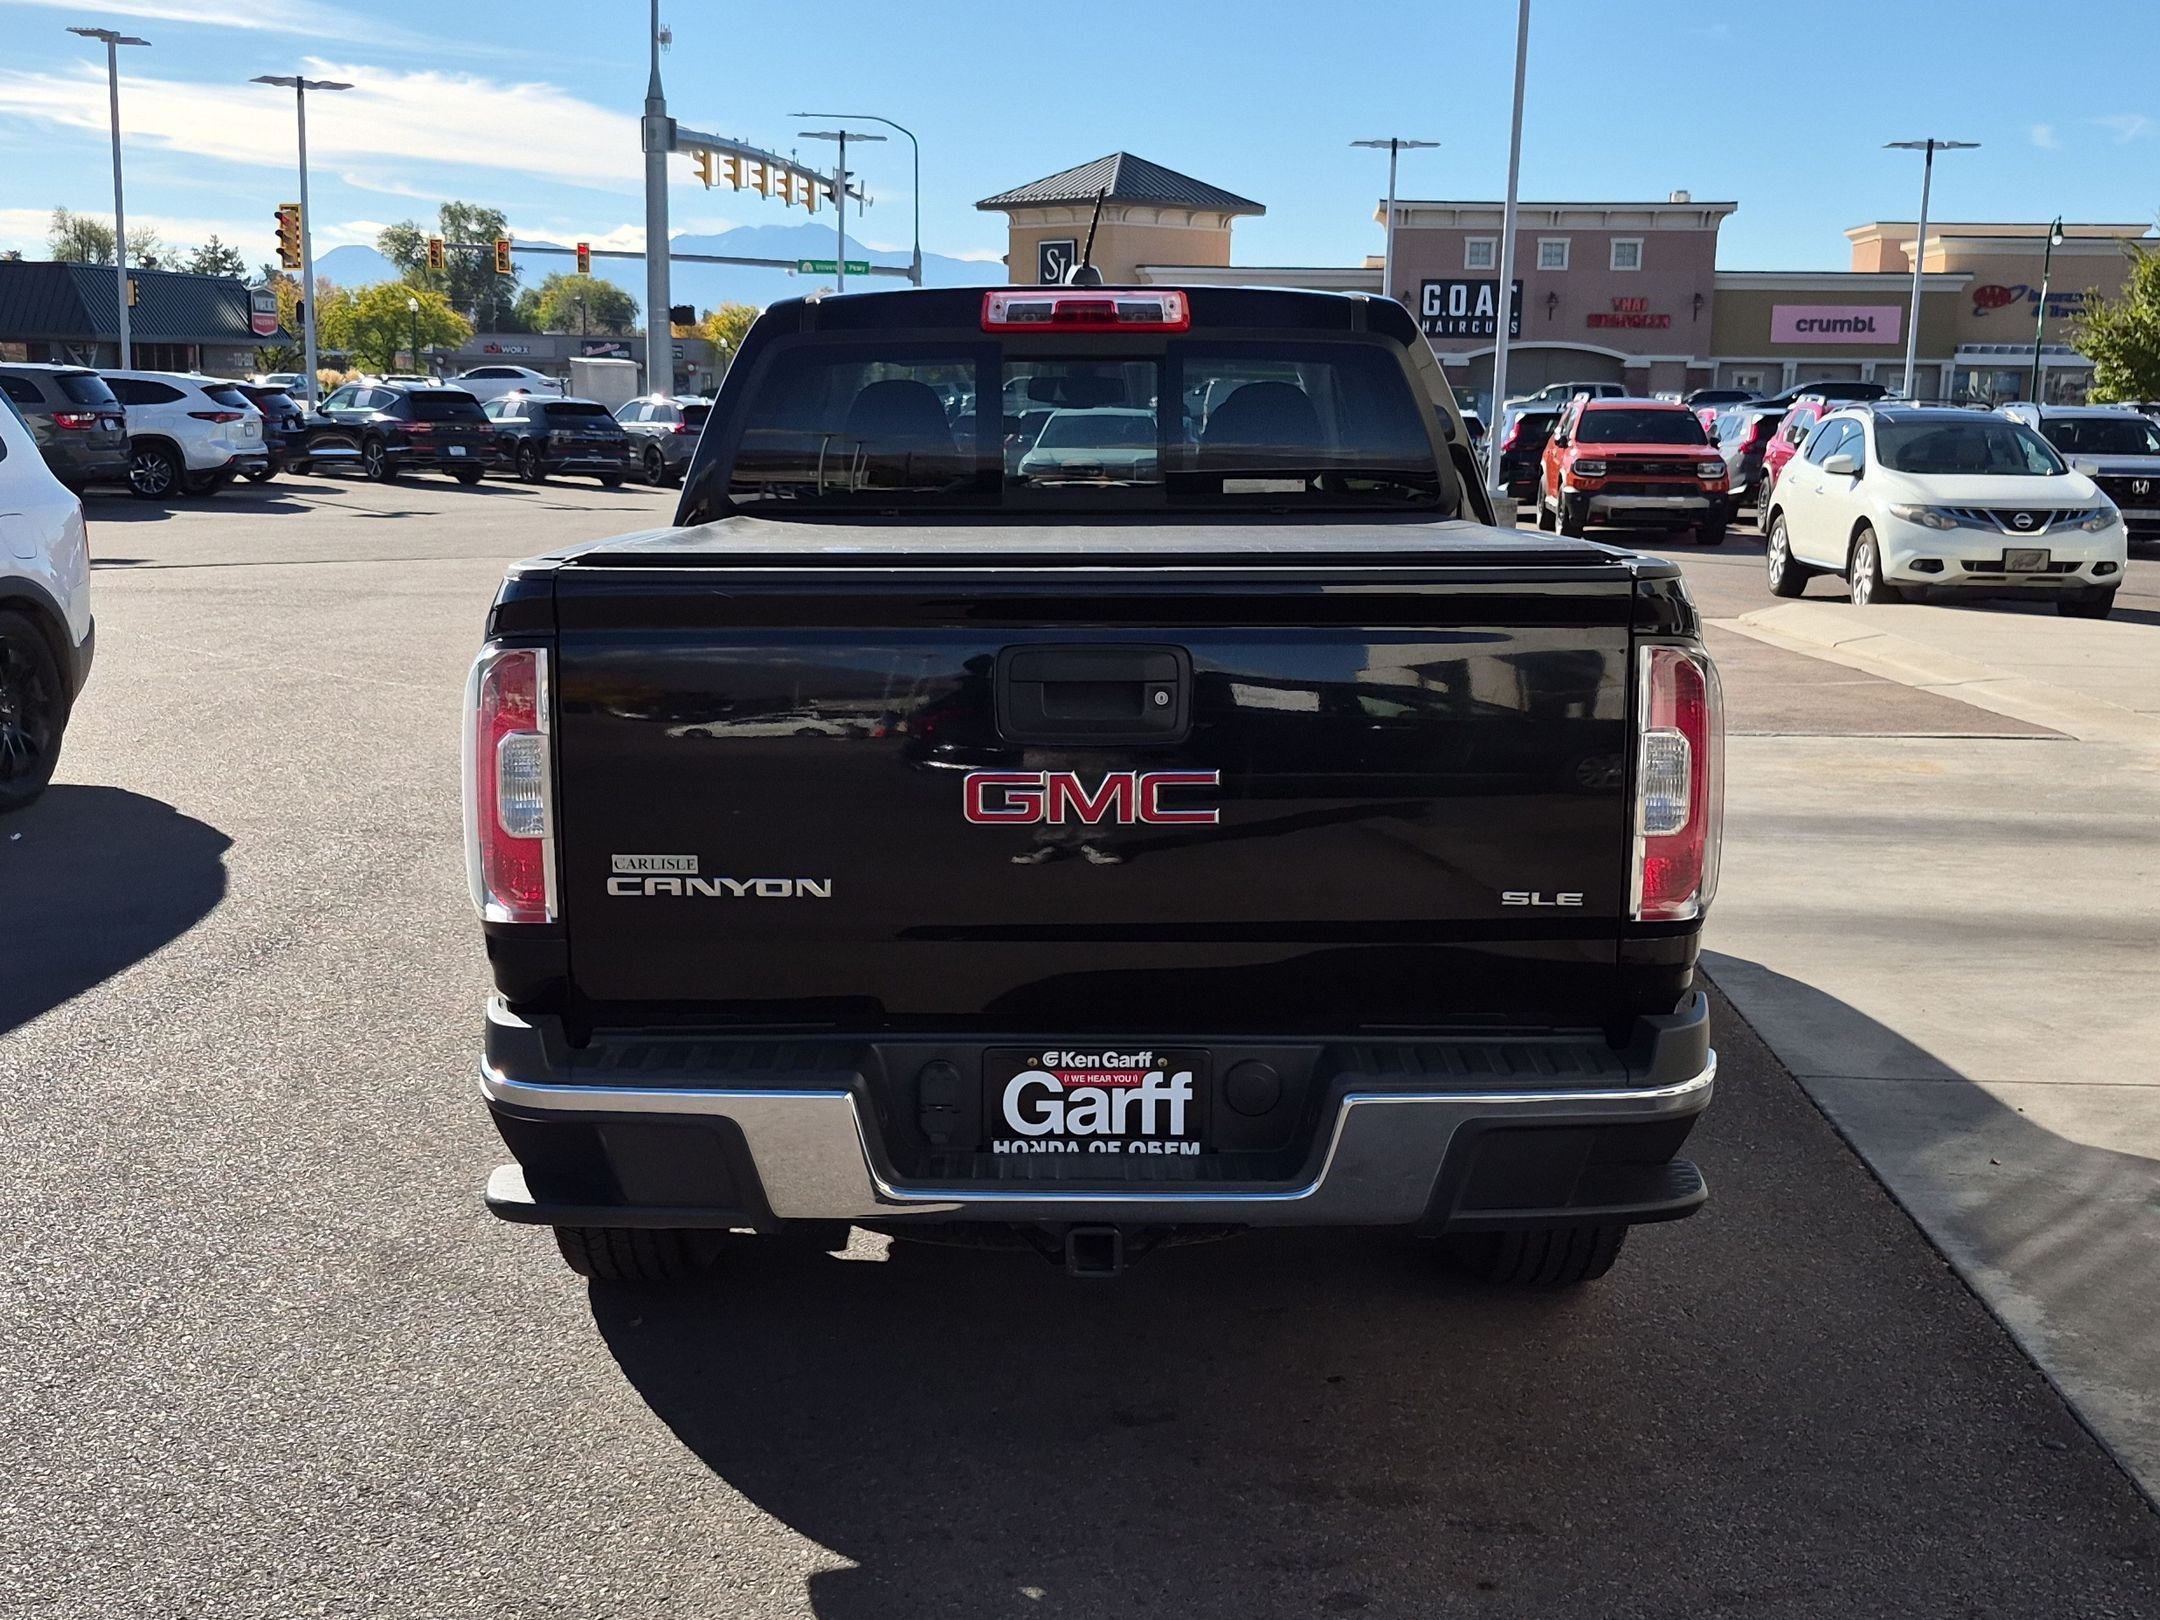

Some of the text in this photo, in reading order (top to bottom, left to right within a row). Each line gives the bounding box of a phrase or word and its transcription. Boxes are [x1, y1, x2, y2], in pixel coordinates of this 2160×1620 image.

[1421, 320, 1518, 334] HAIRCUS
[1795, 316, 1876, 333] crumbl
[963, 769, 1220, 825] GMC
[614, 857, 696, 871] CARLISLE
[607, 876, 832, 898] CANYON
[1501, 891, 1584, 906] SLE
[1061, 1051, 1153, 1068] Ken Garff
[1071, 1074, 1132, 1083] WE HEAR YOU
[1003, 1070, 1193, 1136] Garff
